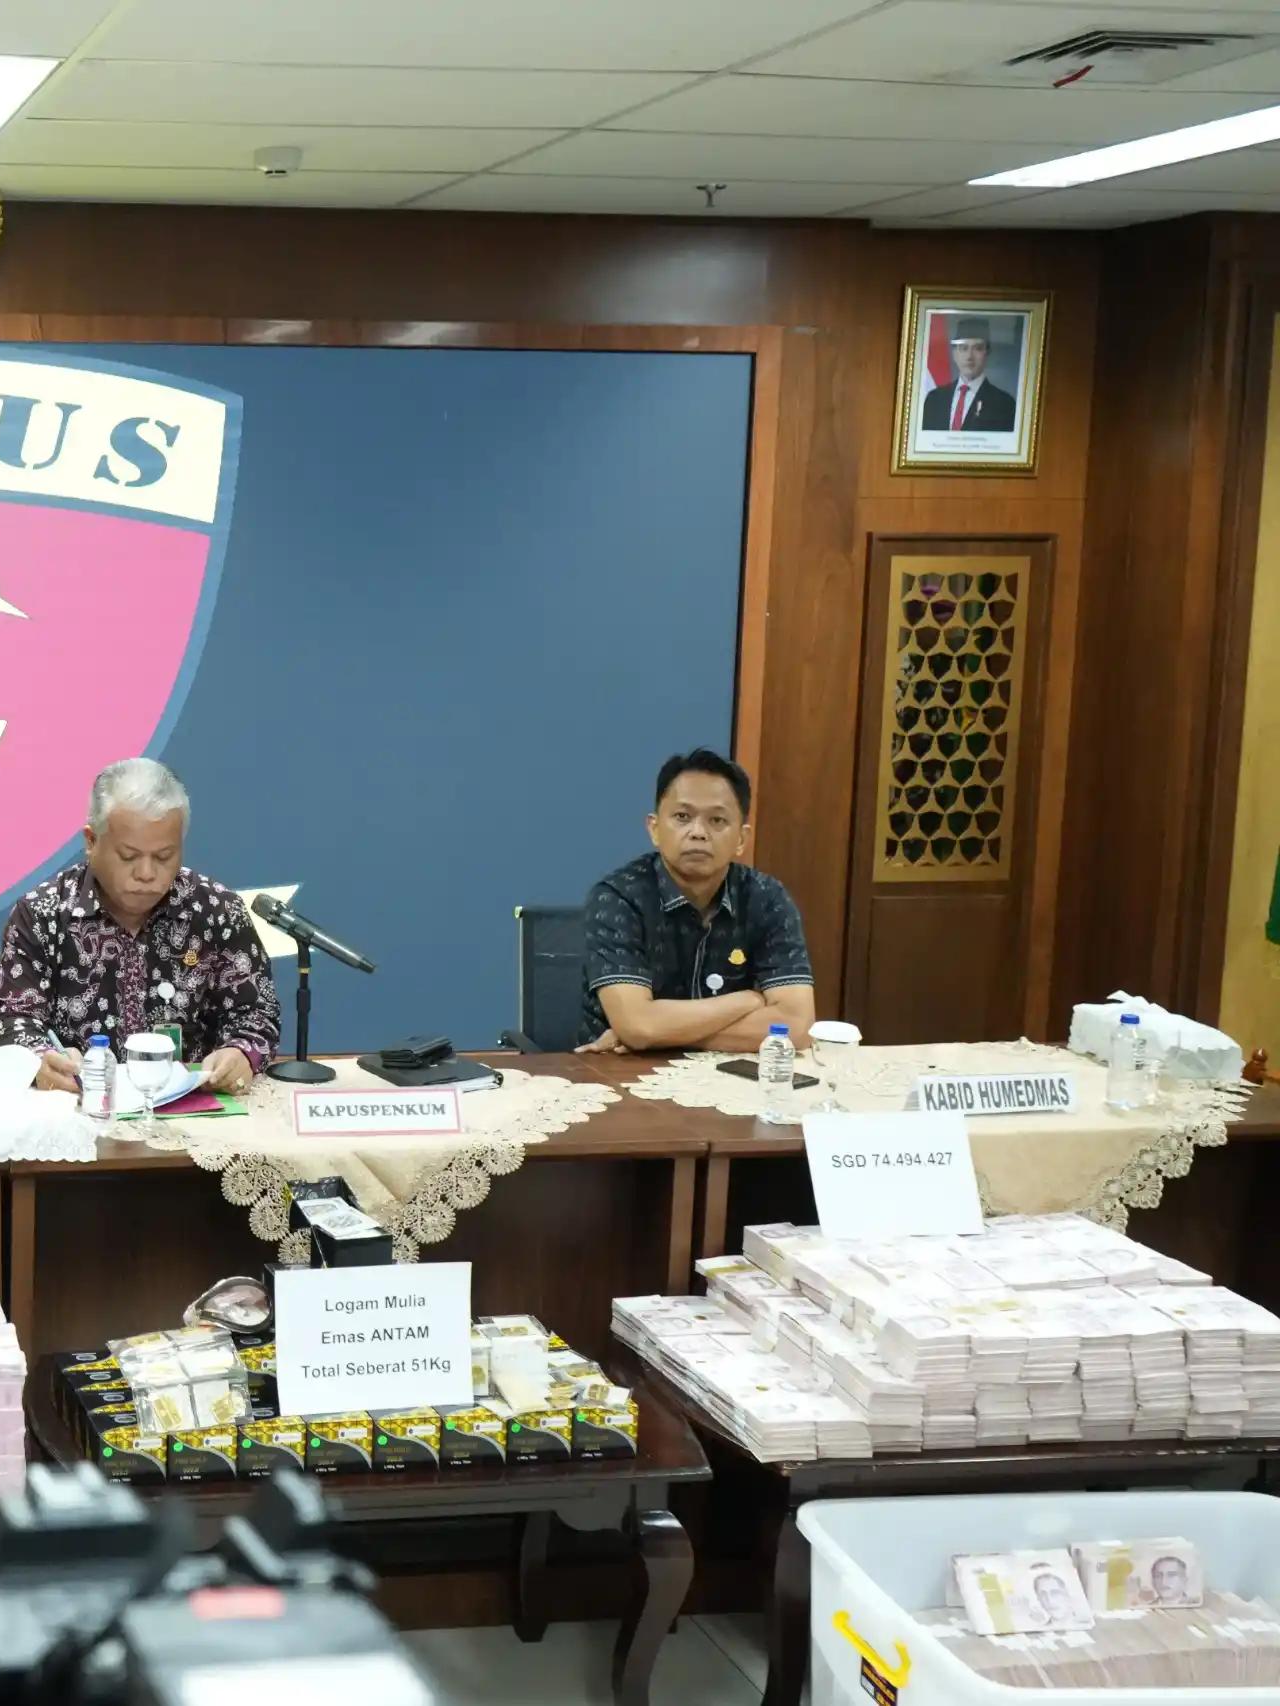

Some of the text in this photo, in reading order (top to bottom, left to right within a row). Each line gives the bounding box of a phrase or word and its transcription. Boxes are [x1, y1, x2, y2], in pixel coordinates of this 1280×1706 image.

[924, 1078, 1070, 1111] KABID HUMEDMAS
[308, 1103, 446, 1118] KAPUSPENKUM
[831, 1151, 953, 1168] SGD 74.494.427
[324, 1294, 426, 1314] Logam Mulia
[321, 1325, 430, 1344] Emas ANTAM
[301, 1356, 452, 1379] Total Seberat 51Kg
